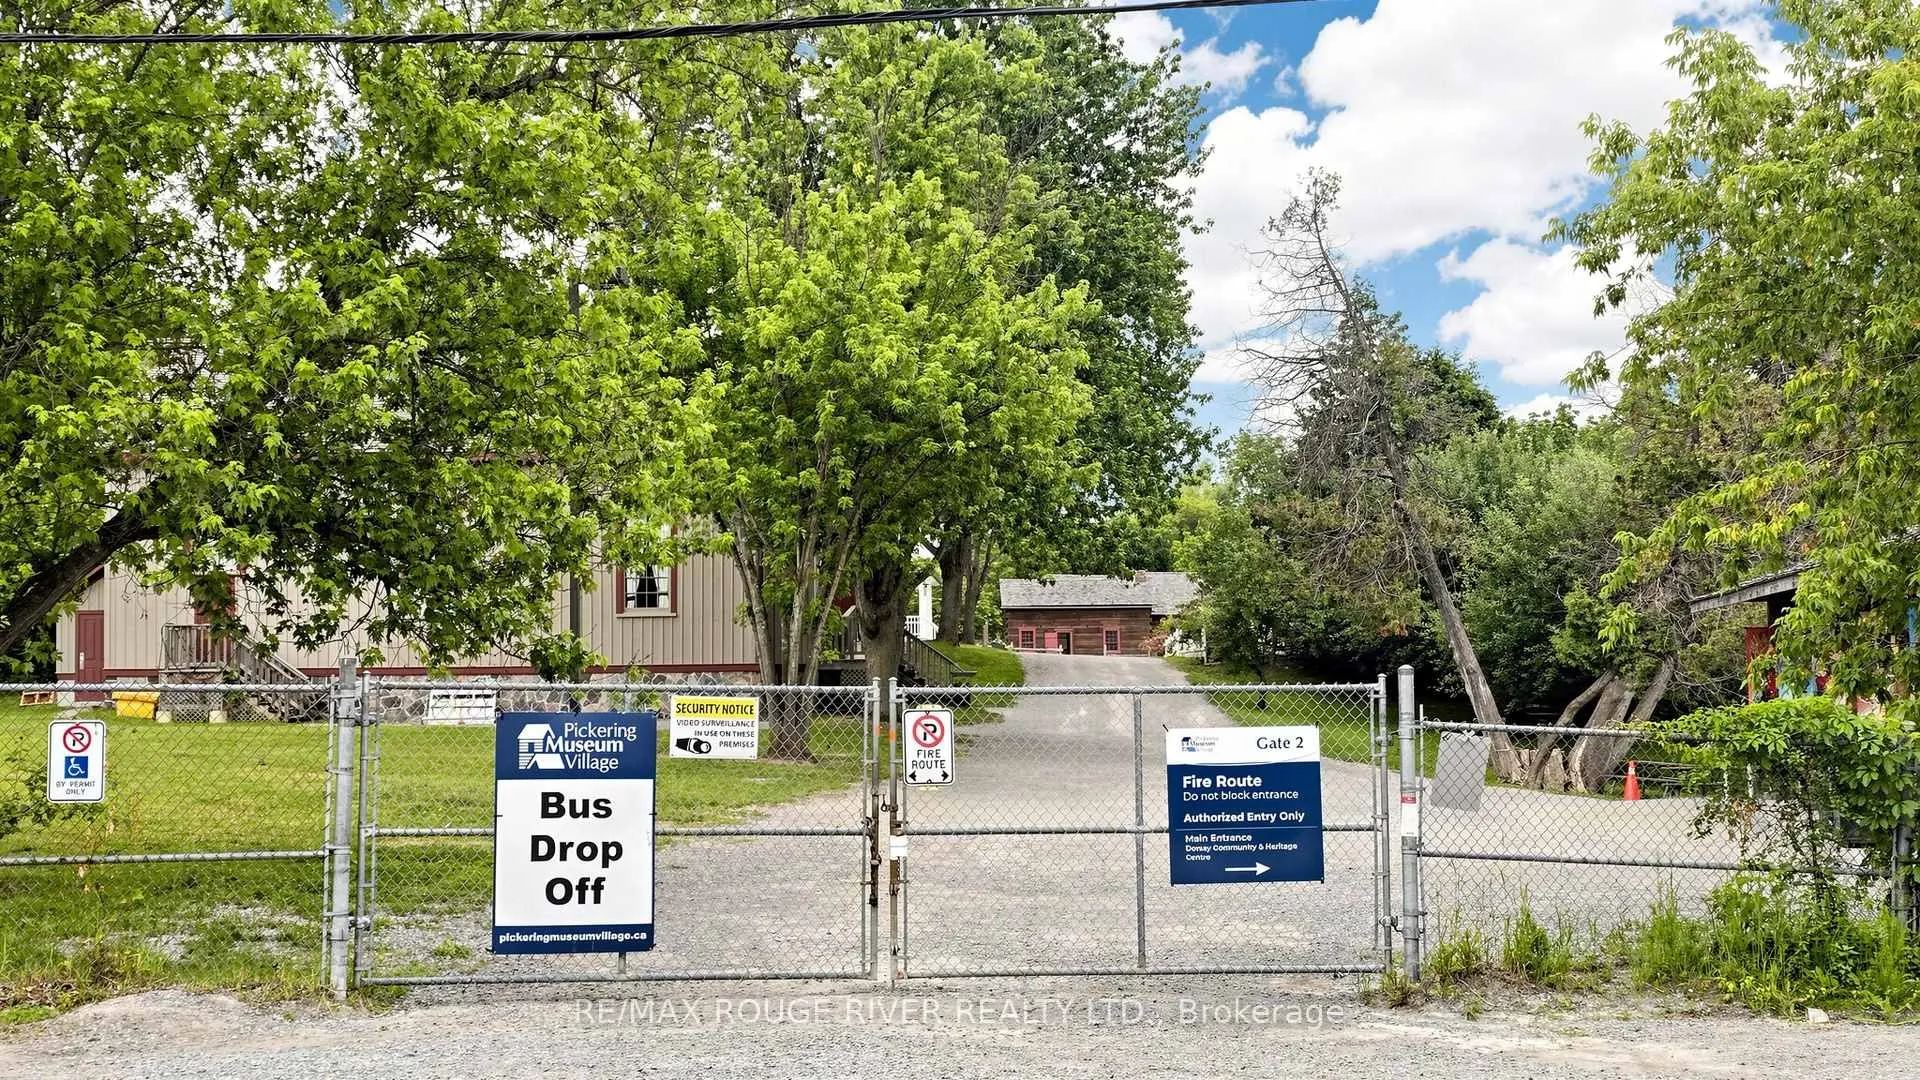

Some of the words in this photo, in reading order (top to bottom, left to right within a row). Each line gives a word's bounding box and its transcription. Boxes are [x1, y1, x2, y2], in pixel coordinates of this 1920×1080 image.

[676, 703, 720, 714] SECURITY
[722, 704, 754, 715] NOTICE
[677, 719, 700, 727] VIDEO
[701, 719, 755, 728] SURVEILLANCE
[564, 722, 637, 741] Pickering
[733, 730, 755, 738] THESE
[546, 736, 624, 753] Museum
[719, 740, 755, 748] PREMISES
[1257, 737, 1291, 750] Gate
[1296, 736, 1304, 749] 2
[917, 749, 941, 759] FIRE
[565, 753, 619, 773] Village
[911, 759, 946, 770] ROUTE
[1183, 775, 1212, 789] Fire
[1216, 775, 1263, 788] Route
[1183, 792, 1199, 801] Do
[1201, 791, 1219, 801] not
[1221, 791, 1250, 800] block
[1252, 790, 1299, 800] entrance
[541, 791, 613, 819] Bus
[1183, 812, 1244, 823] Authorized
[1247, 811, 1277, 823] Entry
[1279, 811, 1305, 823] Only
[1185, 834, 1208, 843] Main
[1210, 834, 1253, 842] Entrance
[530, 834, 623, 869] Drop
[1213, 843, 1257, 852] Community
[1265, 842, 1298, 851] Heritage
[545, 877, 606, 905] Off
[499, 931, 647, 943] pickeringmuseumvillage.ca
